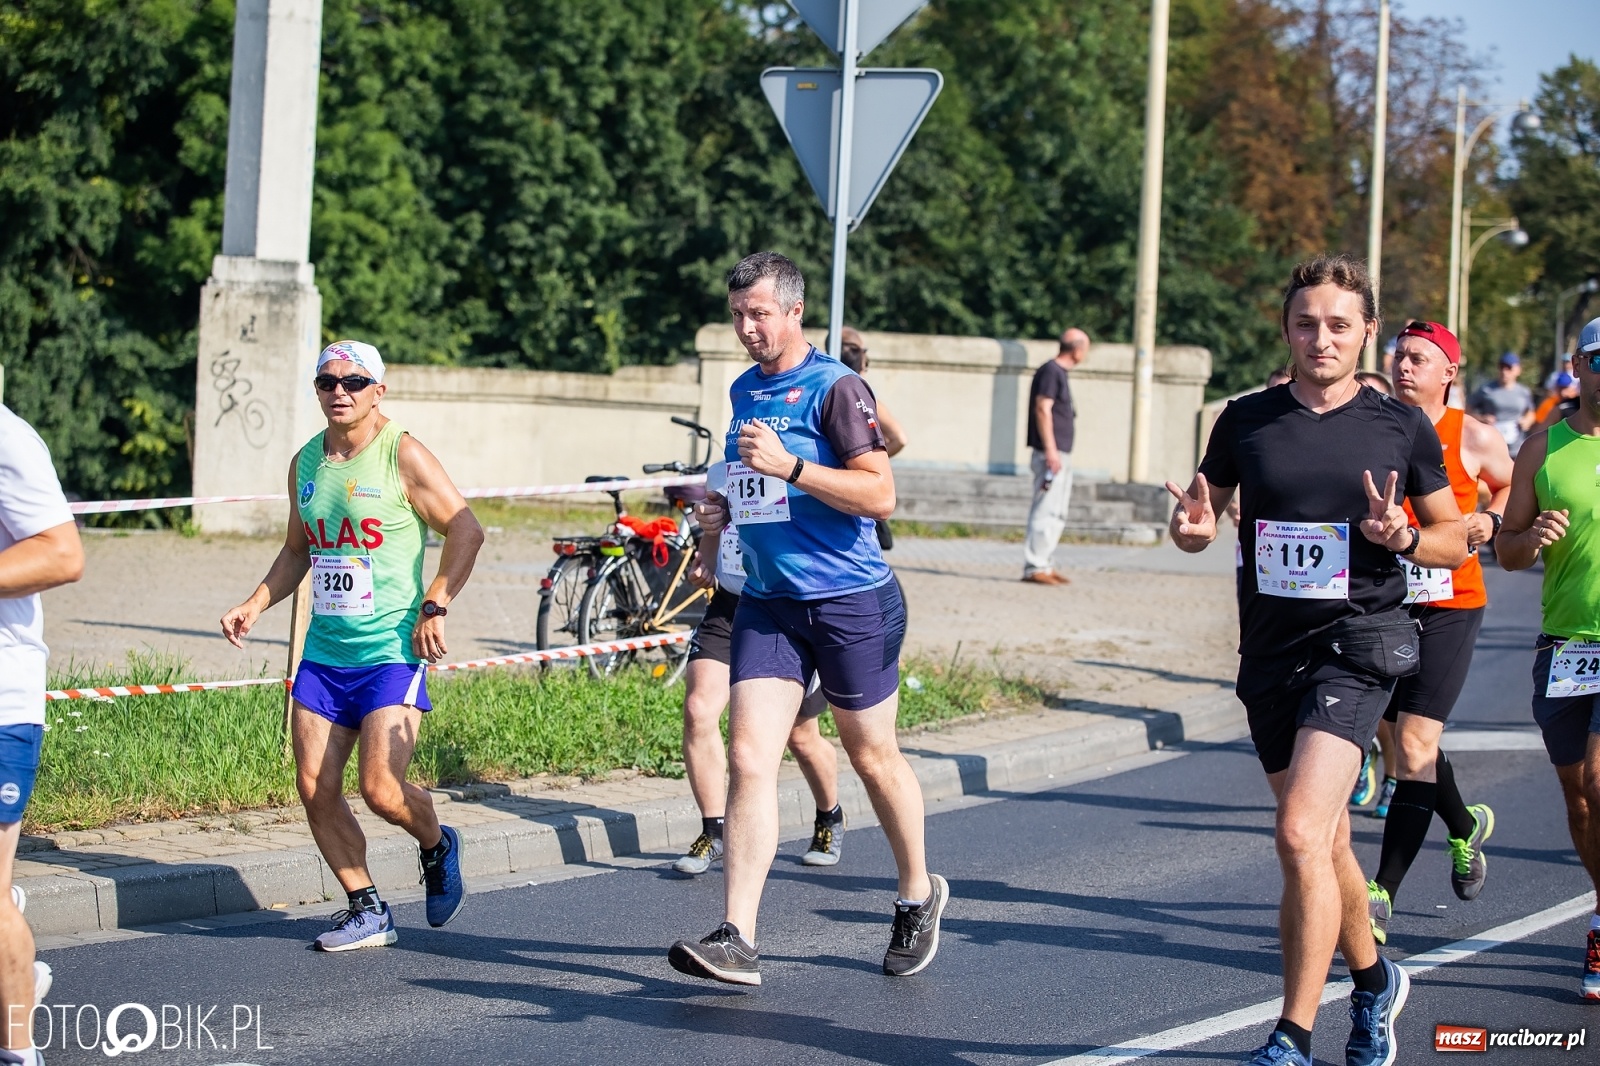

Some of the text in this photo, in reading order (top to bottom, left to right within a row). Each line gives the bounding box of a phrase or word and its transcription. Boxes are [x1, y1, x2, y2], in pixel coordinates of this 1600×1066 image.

[355, 485, 382, 494] Dystans
[738, 476, 765, 499] 151
[1280, 542, 1324, 569] 119
[324, 572, 353, 591] 320
